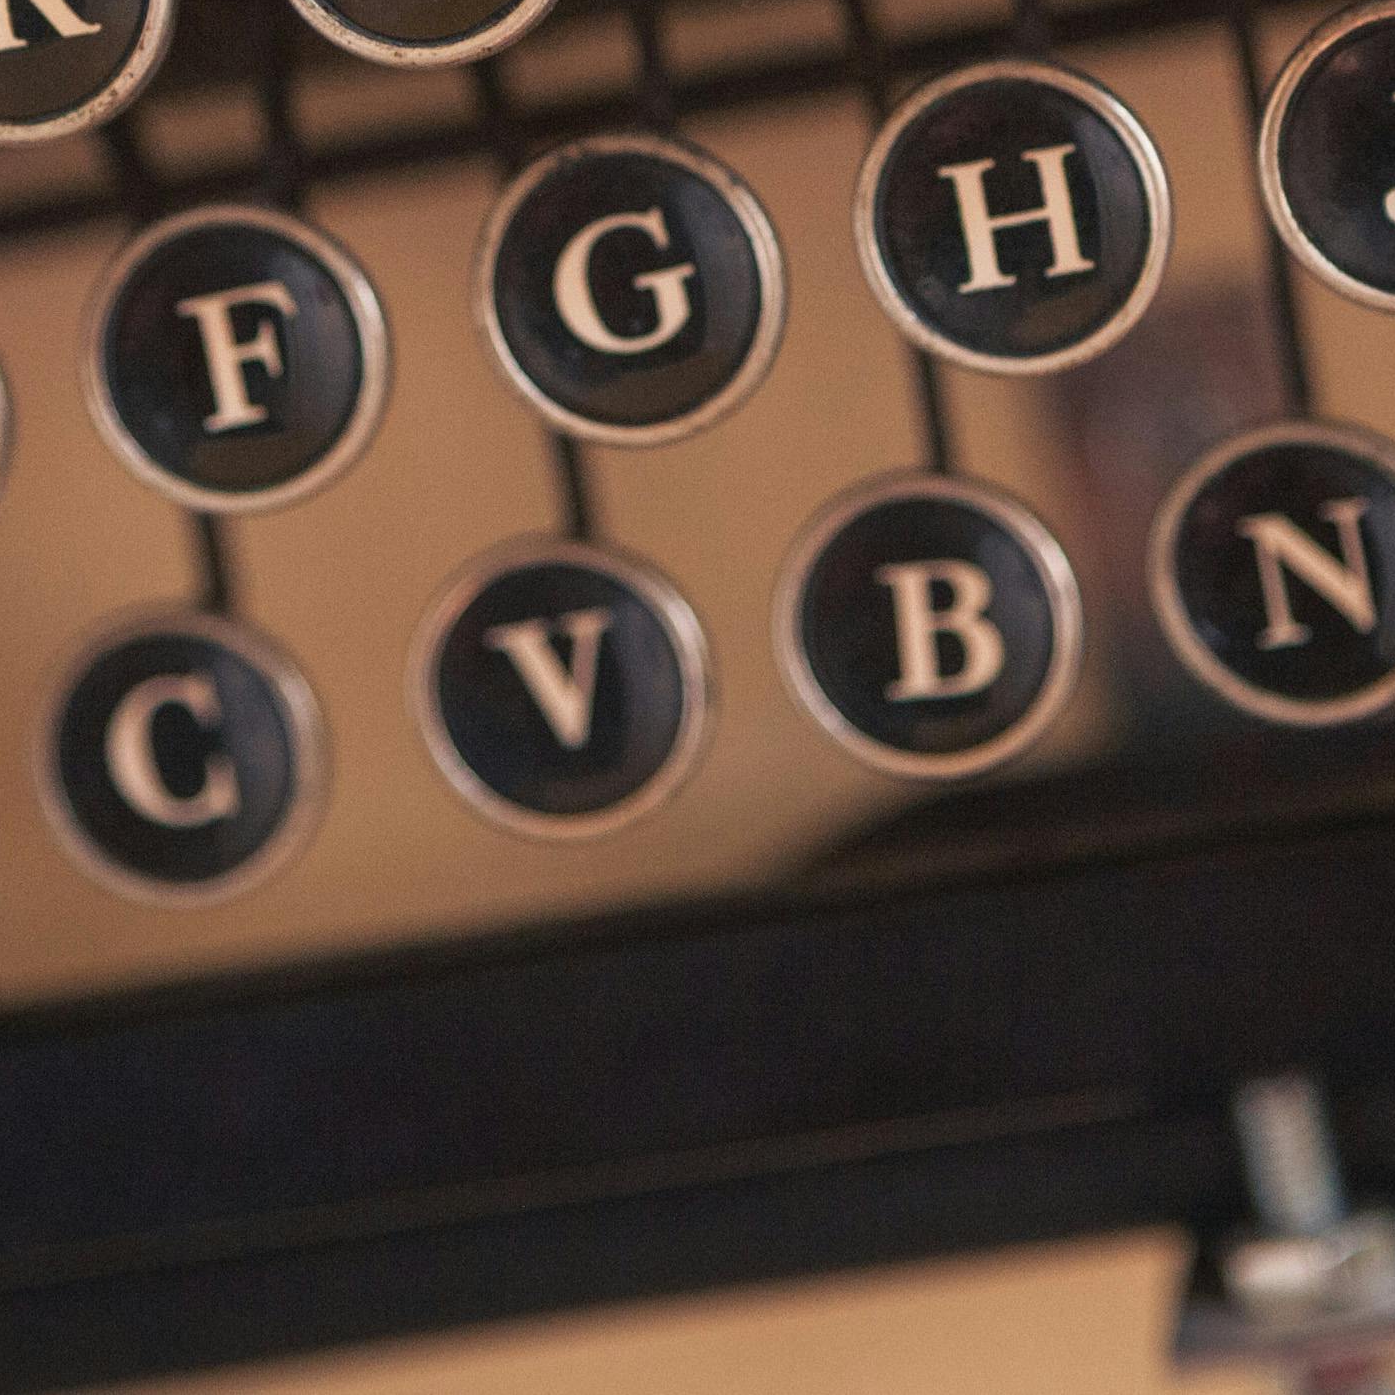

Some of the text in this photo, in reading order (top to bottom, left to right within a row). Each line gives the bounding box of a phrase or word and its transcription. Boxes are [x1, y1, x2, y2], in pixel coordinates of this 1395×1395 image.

[554, 210, 693, 353] G
[939, 145, 1097, 294] H
[177, 280, 300, 433] F
[879, 560, 1007, 699] B
[1243, 498, 1381, 650] N
[105, 675, 239, 825] C
[485, 609, 611, 749] V
